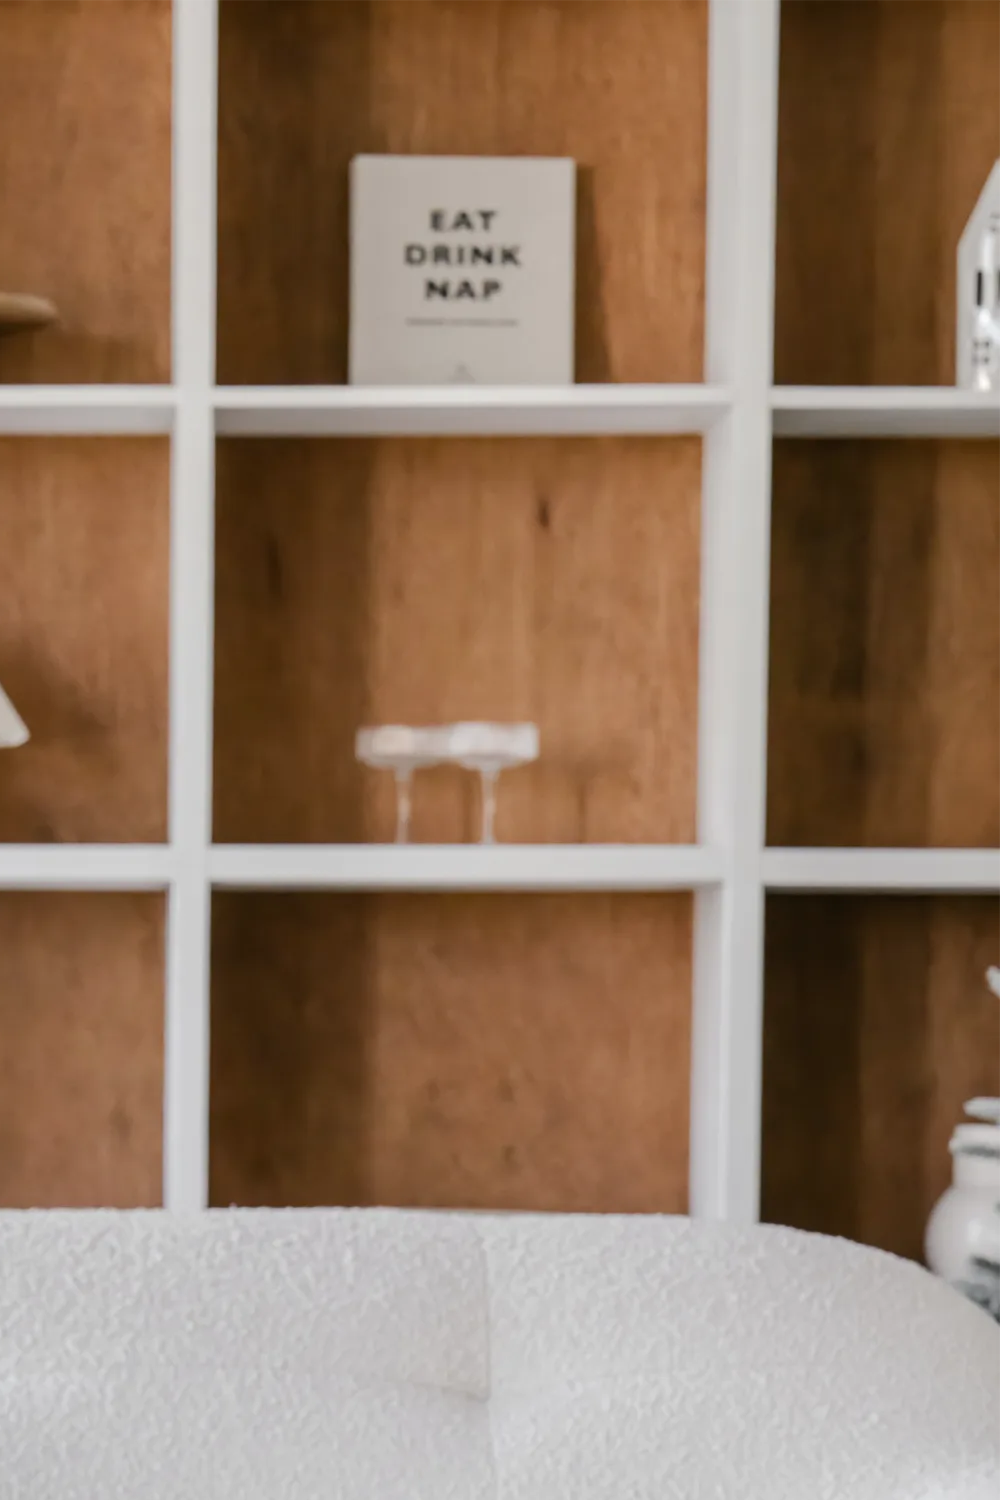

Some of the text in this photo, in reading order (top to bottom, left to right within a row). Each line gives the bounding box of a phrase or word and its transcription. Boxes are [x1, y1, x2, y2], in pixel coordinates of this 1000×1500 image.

[430, 209, 496, 232] EAT
[405, 244, 520, 267] DRINK
[425, 279, 502, 301] NAP
